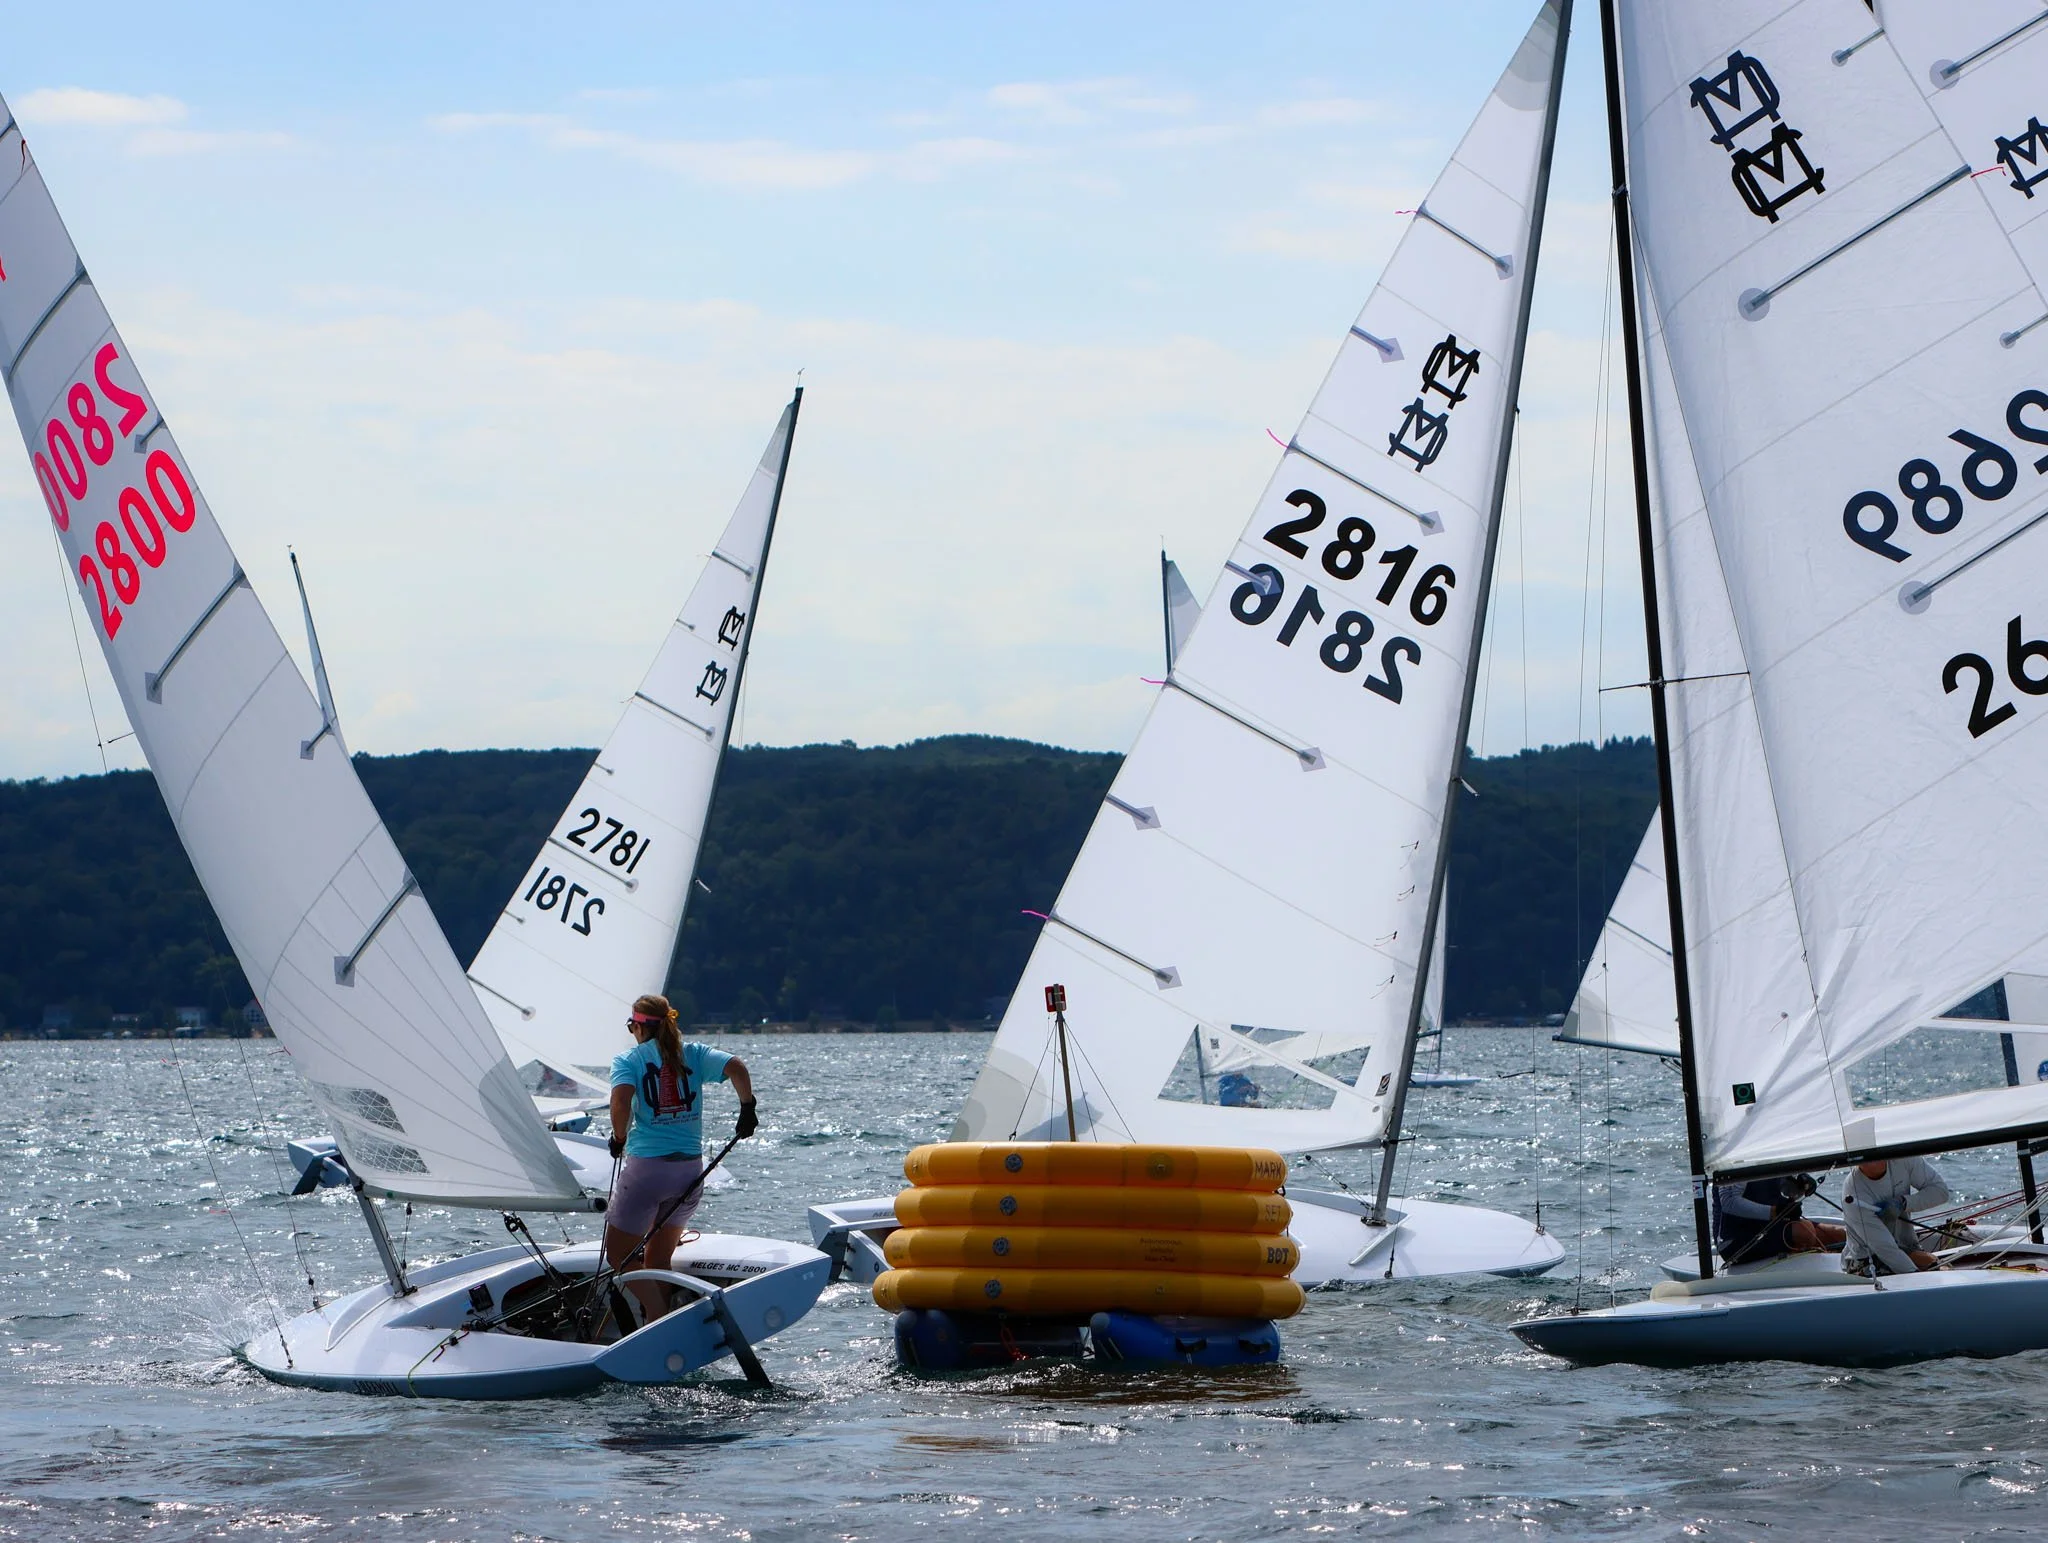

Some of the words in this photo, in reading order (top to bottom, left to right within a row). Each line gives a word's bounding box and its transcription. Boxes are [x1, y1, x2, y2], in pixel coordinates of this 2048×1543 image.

[78, 449, 196, 641] 2800
[1262, 488, 1456, 626] 2816
[566, 807, 651, 874] 2781
[1255, 1161, 1282, 1180] MARK
[1264, 1204, 1281, 1223] SET
[1267, 1246, 1289, 1265] BOT
[690, 1261, 725, 1271] MELGES
[726, 1264, 741, 1272] MC
[741, 1265, 767, 1274] 2800
